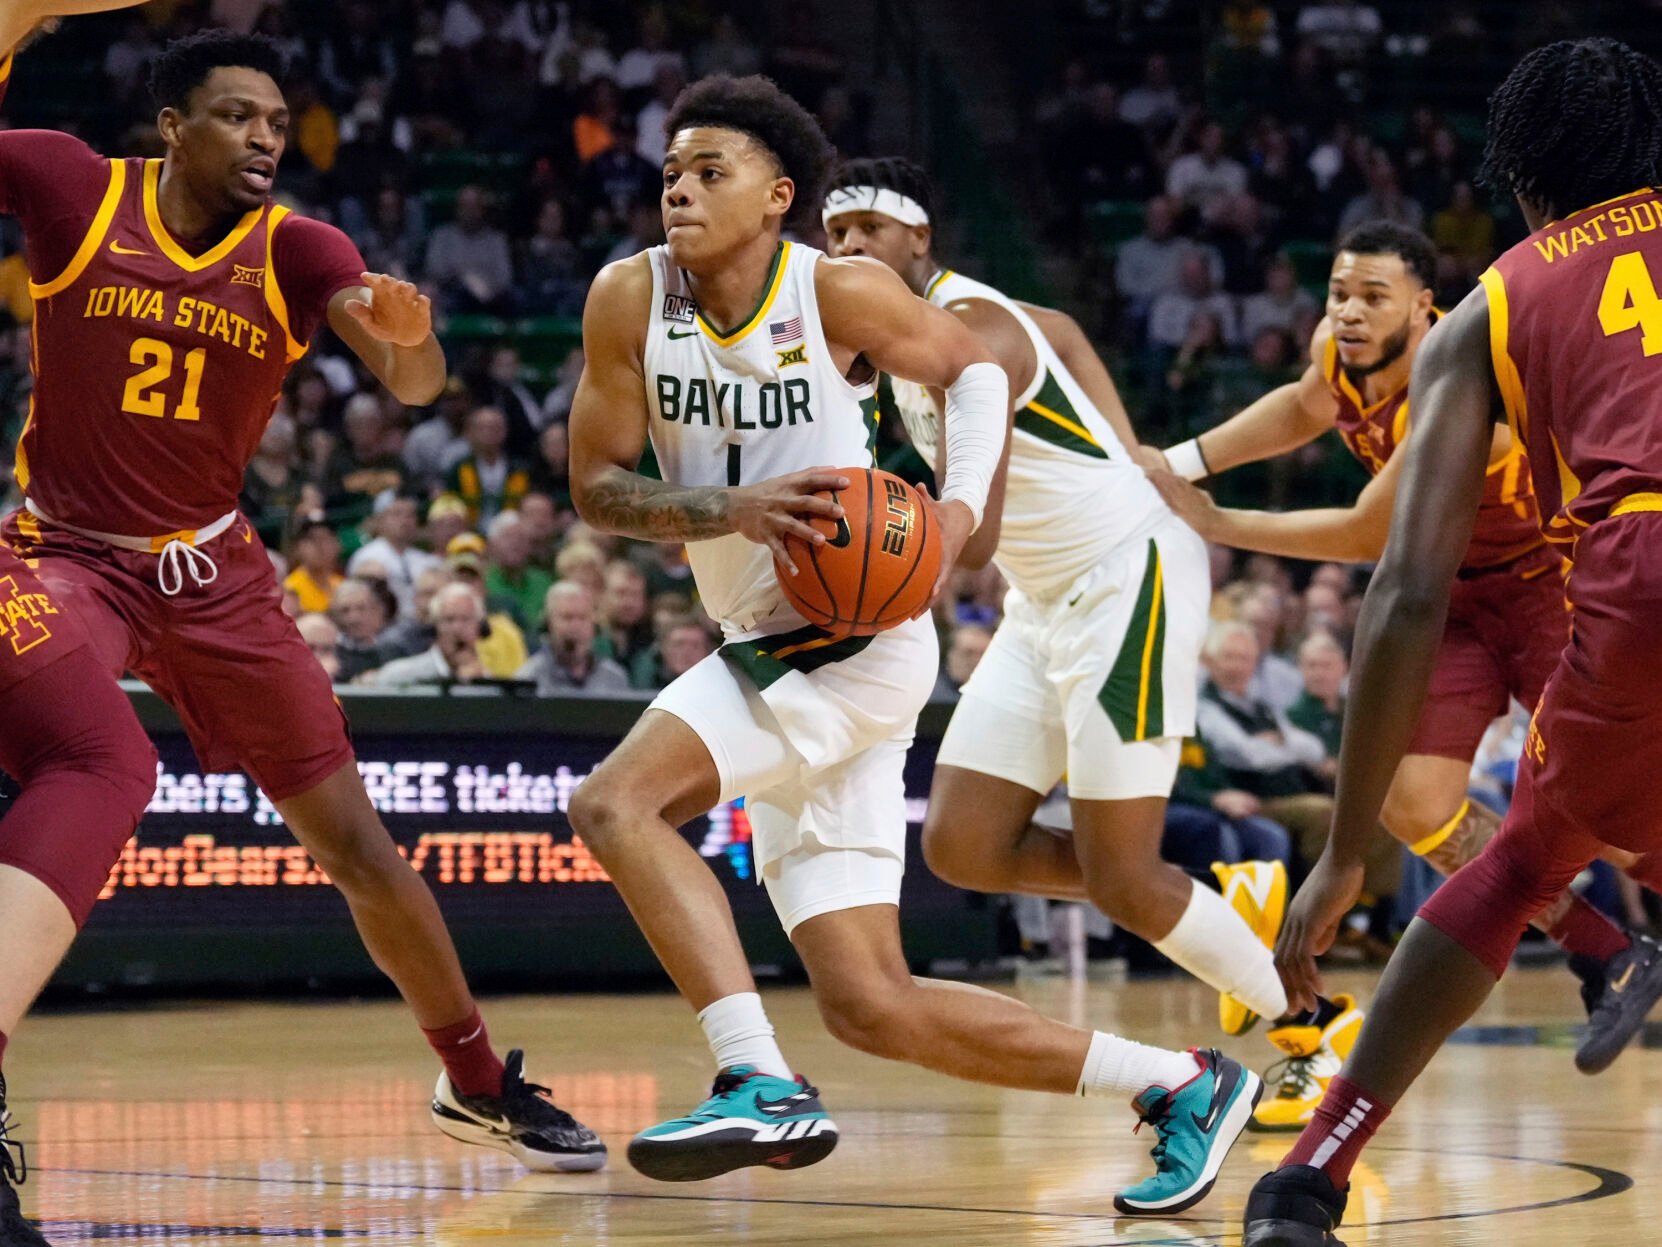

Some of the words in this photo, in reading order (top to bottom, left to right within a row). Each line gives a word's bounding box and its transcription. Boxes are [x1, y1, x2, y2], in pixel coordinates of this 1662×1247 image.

[84, 286, 164, 322] IOWA
[174, 298, 268, 360] STATE
[664, 296, 696, 318] ONE
[1597, 251, 1662, 357] 4
[121, 337, 206, 421] 21
[657, 374, 813, 429] BAYLOR
[881, 479, 909, 558] ELITE
